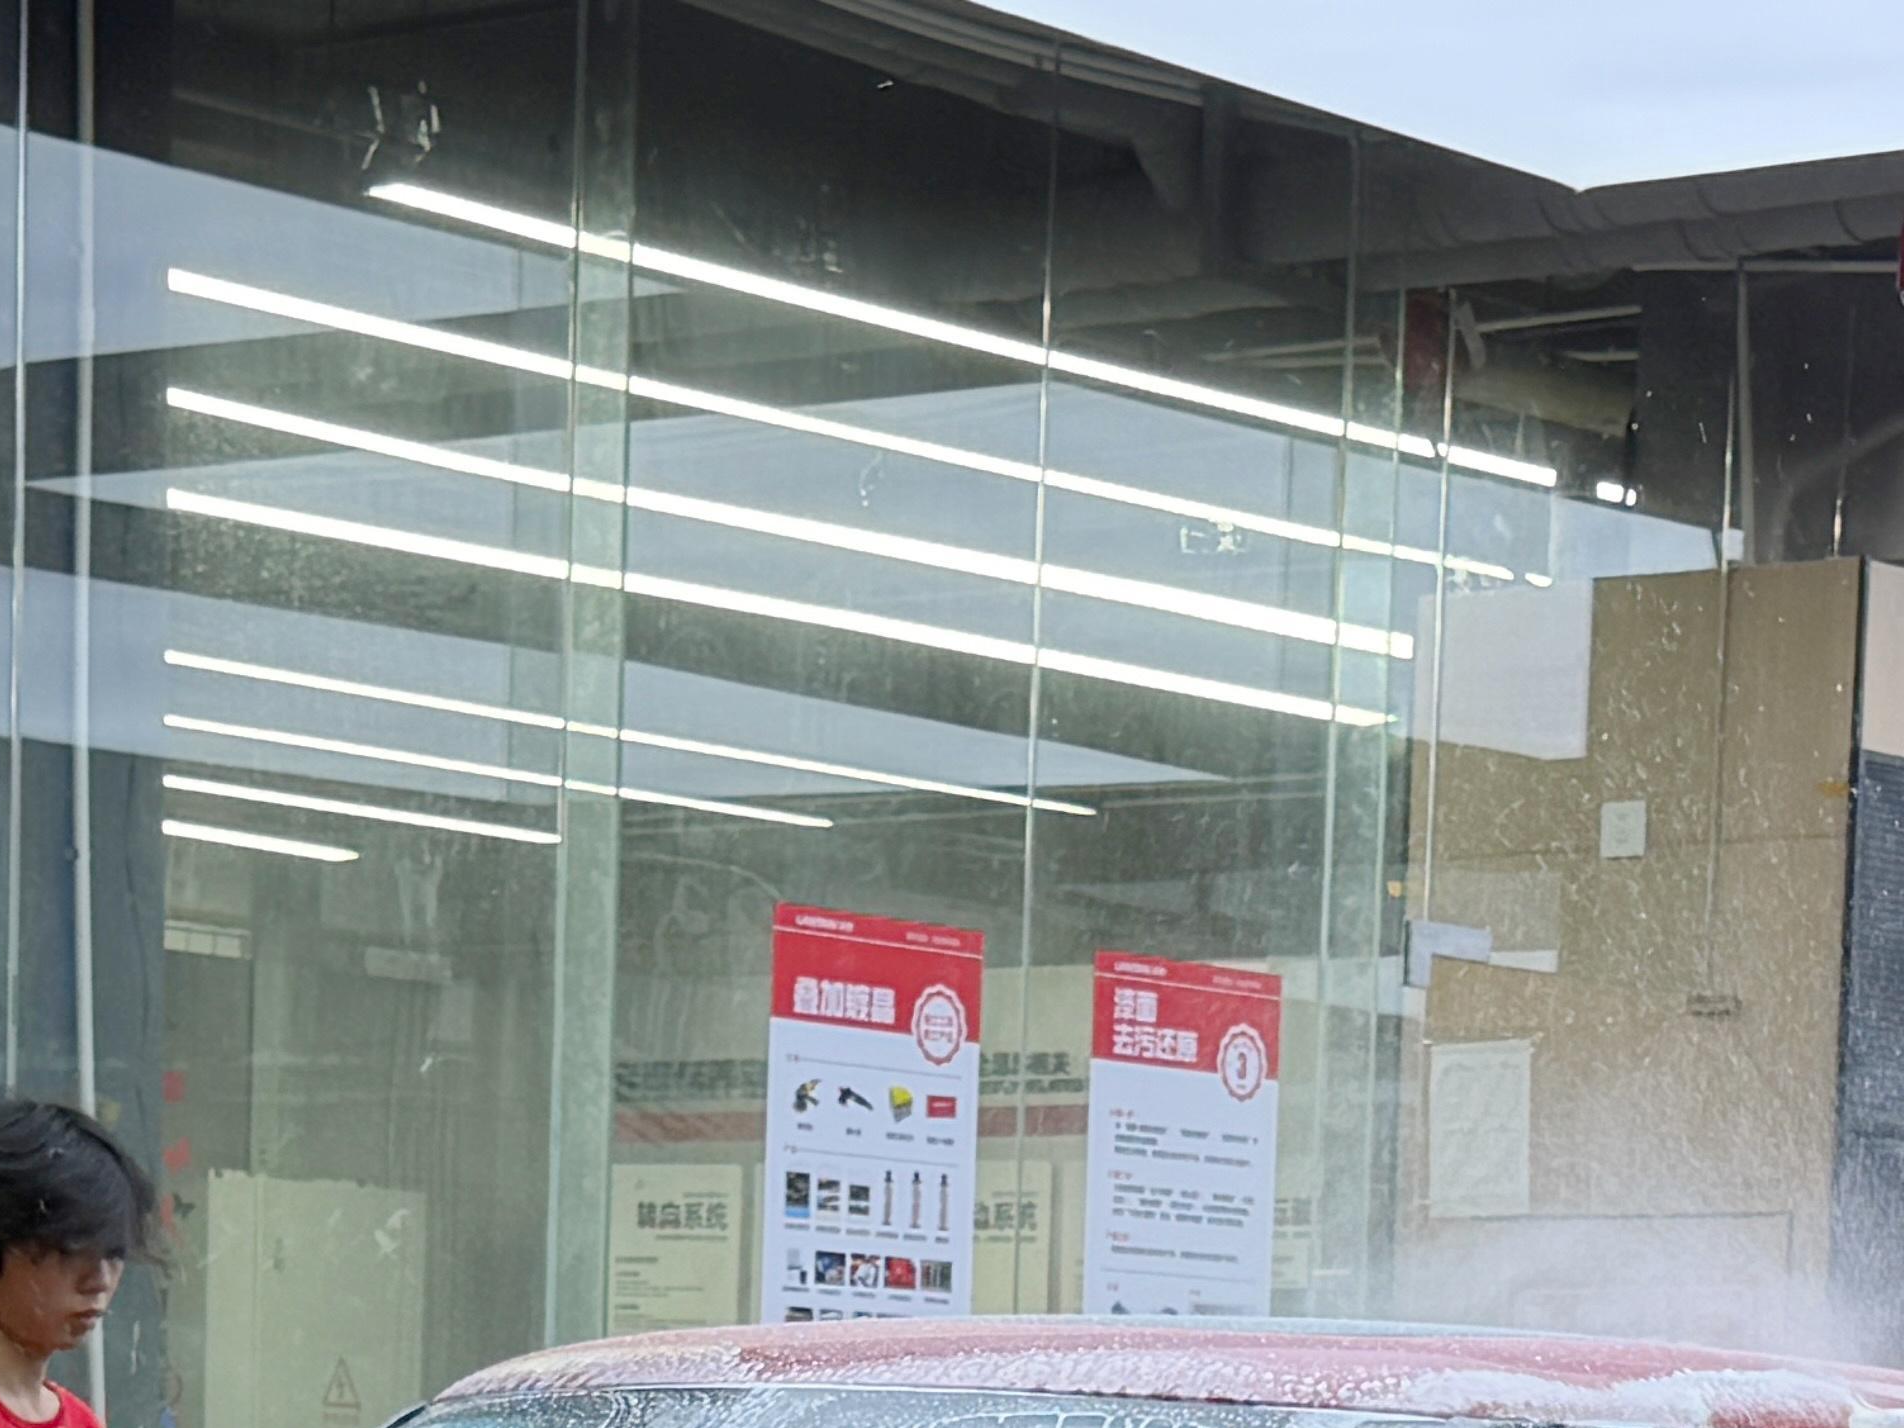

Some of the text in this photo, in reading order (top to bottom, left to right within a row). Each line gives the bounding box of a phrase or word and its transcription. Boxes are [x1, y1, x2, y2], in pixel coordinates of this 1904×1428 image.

[1112, 1023, 1199, 1063] 去污还原
[636, 1201, 729, 1231] 转向系统
